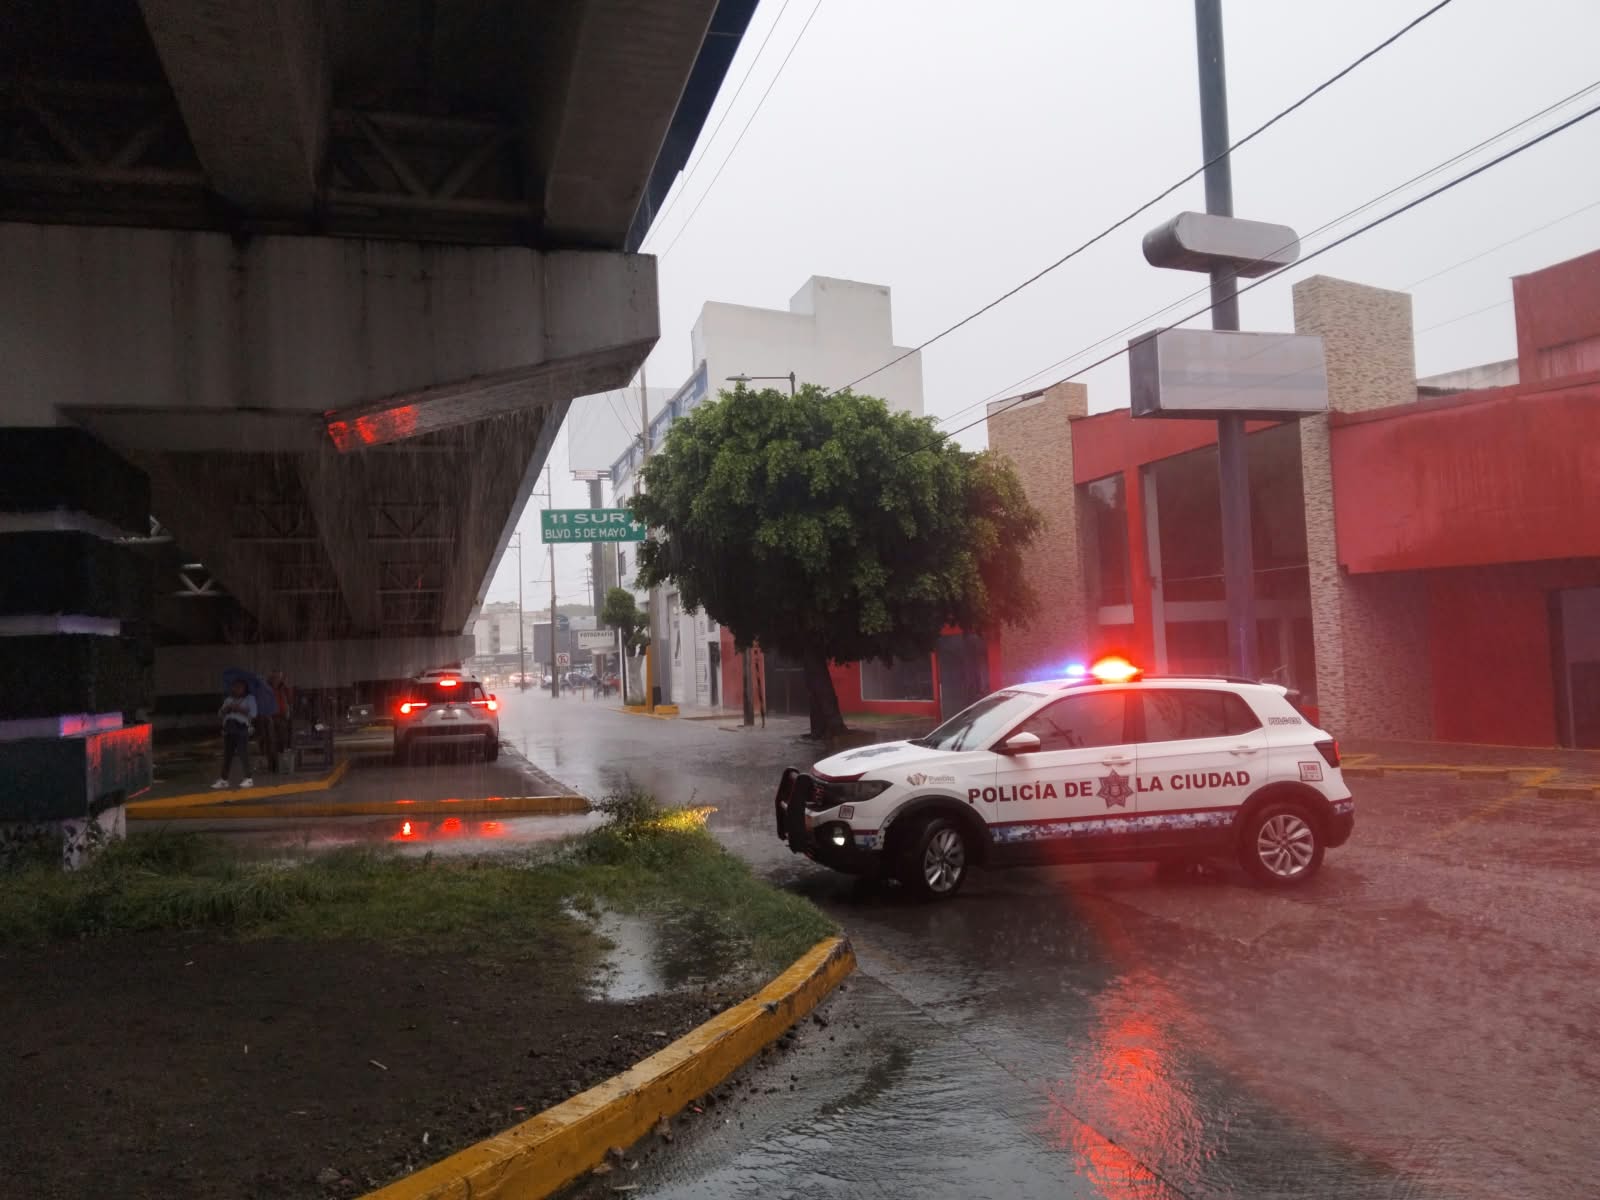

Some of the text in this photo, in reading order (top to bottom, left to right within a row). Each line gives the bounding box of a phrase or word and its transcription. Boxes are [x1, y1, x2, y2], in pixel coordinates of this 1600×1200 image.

[550, 513, 625, 523] 11 SUR
[545, 528, 626, 538] BLVD 5 DE MAYO
[968, 771, 1250, 804] POLICÍA DE LA CIUDAD
